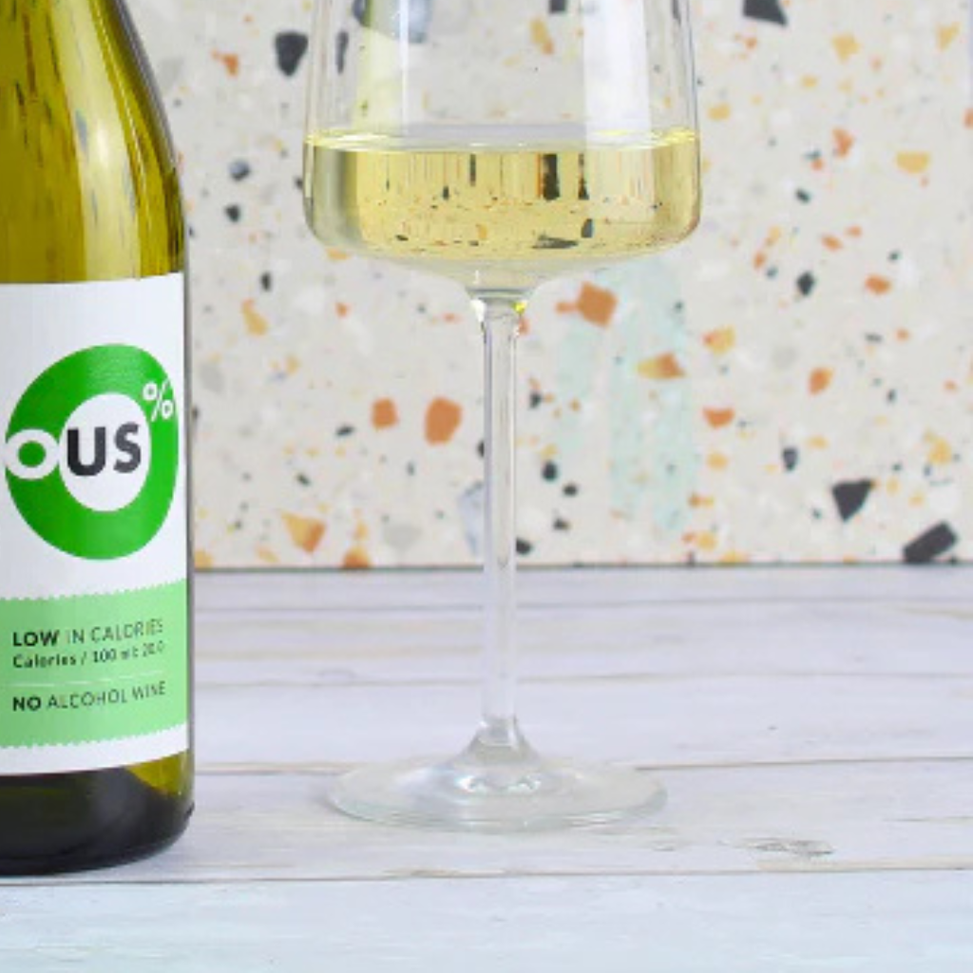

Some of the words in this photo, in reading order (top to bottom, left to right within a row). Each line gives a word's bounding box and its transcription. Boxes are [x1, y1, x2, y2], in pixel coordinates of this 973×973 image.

[12, 630, 60, 647] LOW
[67, 628, 85, 644] IN
[90, 618, 164, 643] CALORIES
[12, 653, 77, 668] Calories
[93, 648, 117, 664] 100
[12, 696, 42, 712] NO
[46, 688, 128, 710] ALCOHOL
[132, 680, 166, 701] WINE
